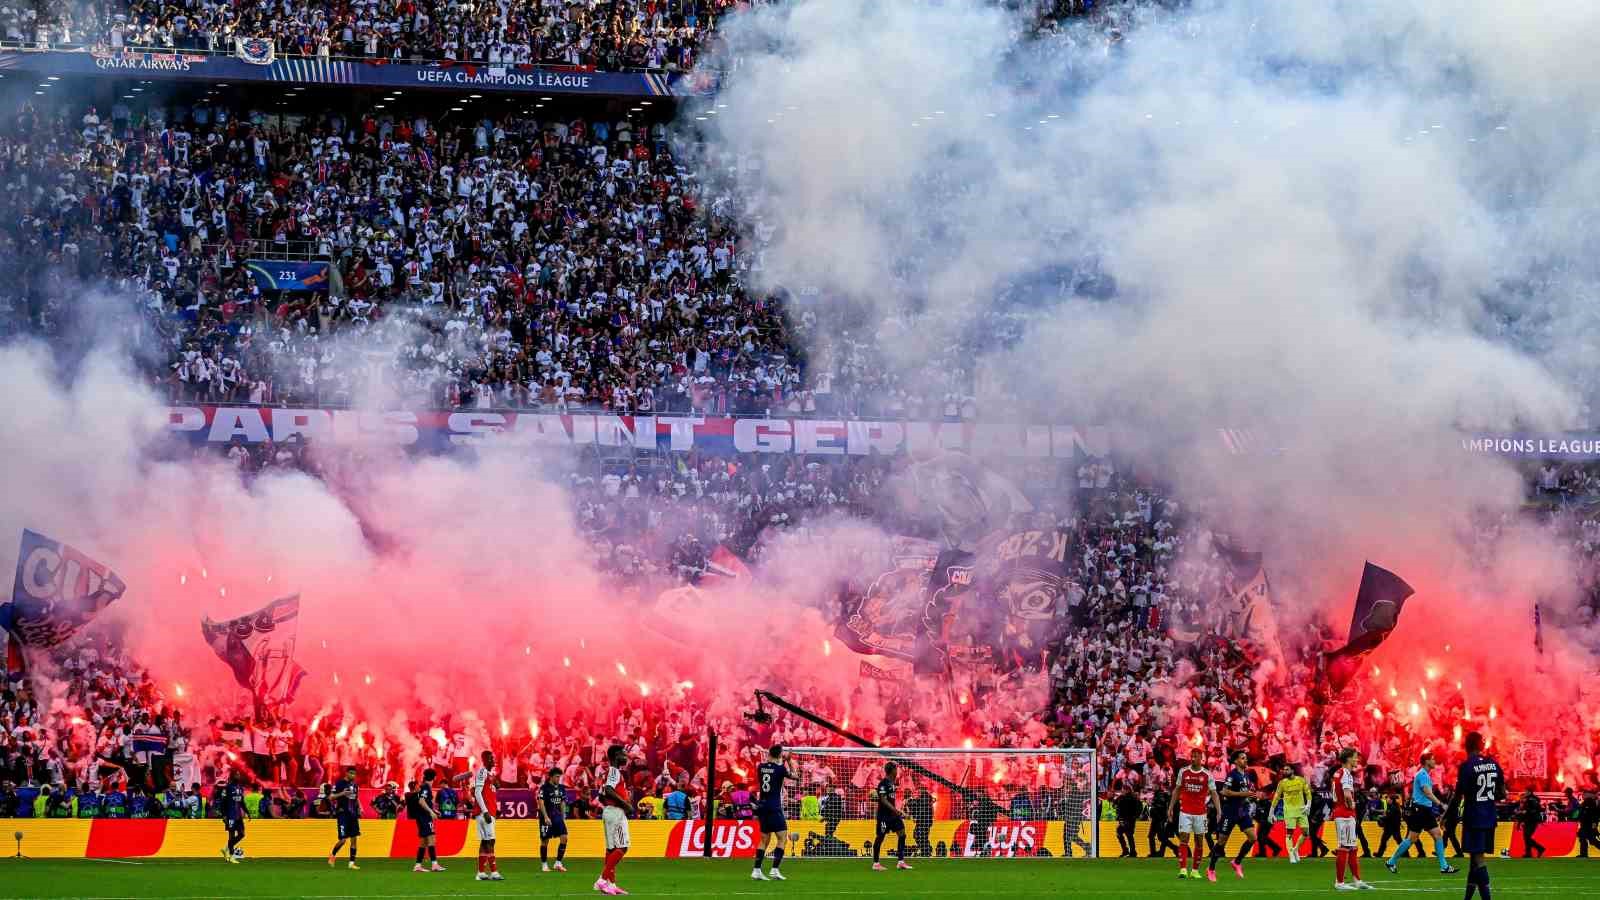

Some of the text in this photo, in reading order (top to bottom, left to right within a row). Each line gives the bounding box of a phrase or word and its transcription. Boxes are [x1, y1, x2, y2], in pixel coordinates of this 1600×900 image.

[95, 58, 191, 71] QATAR AIRWAYS
[417, 70, 589, 88] UEFA CHAMPIONS LEAGUE
[279, 271, 297, 280] 231
[761, 773, 772, 793] 8
[1476, 772, 1498, 802] 25
